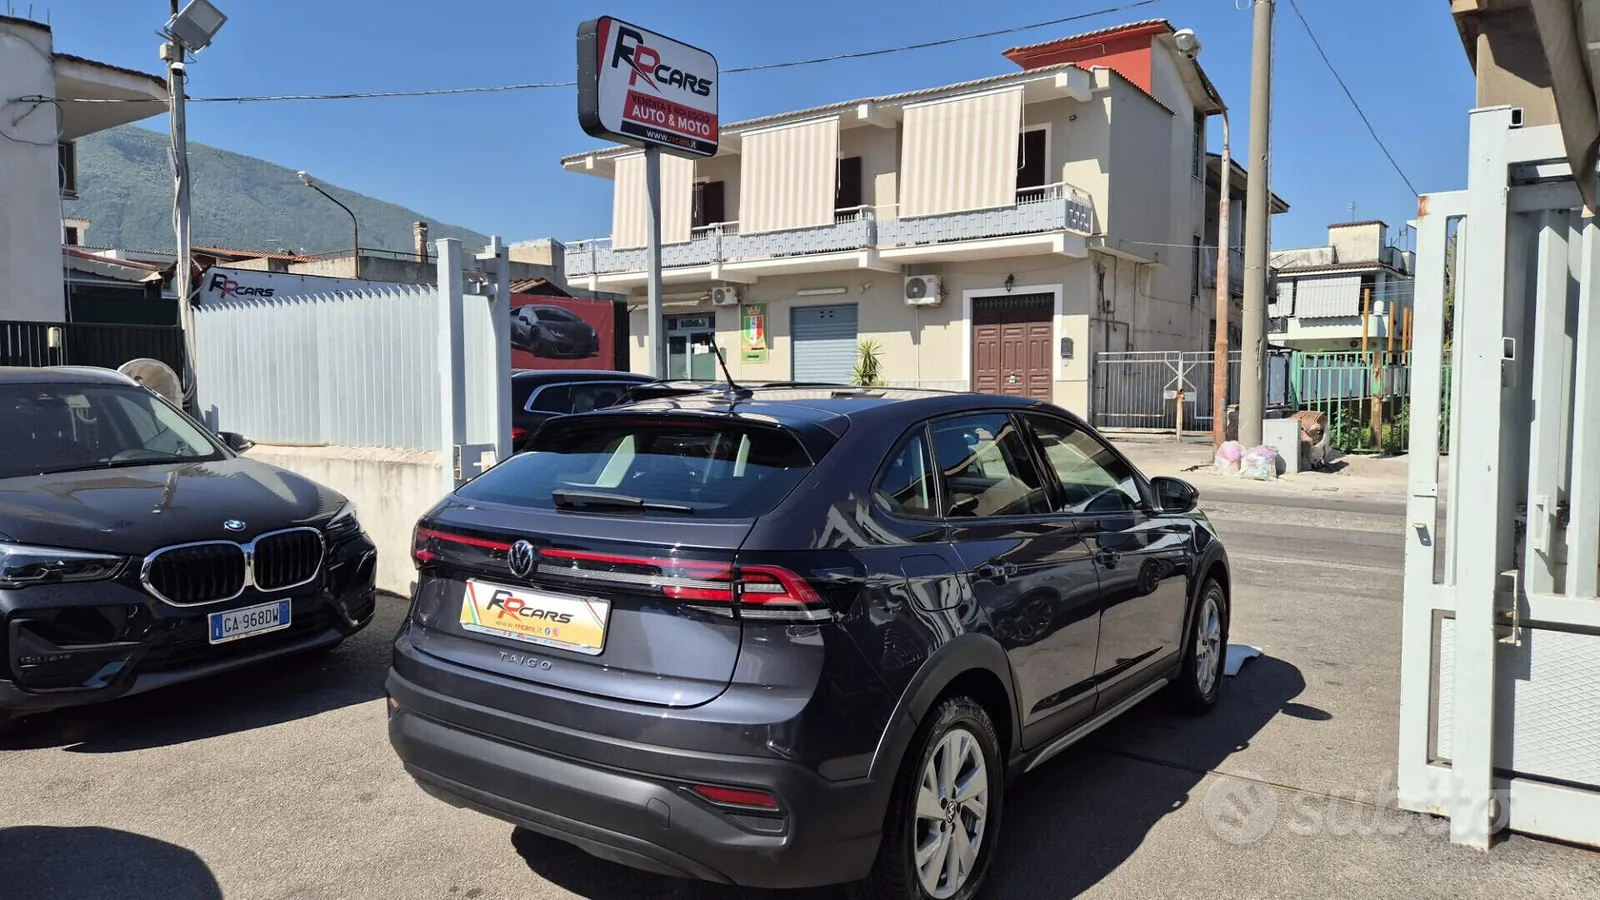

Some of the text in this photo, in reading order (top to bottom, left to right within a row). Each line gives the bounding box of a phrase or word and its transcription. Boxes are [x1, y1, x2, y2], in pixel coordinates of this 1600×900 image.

[632, 94, 665, 112] VENDITA
[674, 105, 709, 123] NOLEGGIO
[632, 104, 710, 136] AUTO & MOTO
[495, 620, 542, 634] www.rrcars.it
[500, 651, 553, 671] TAIGO
